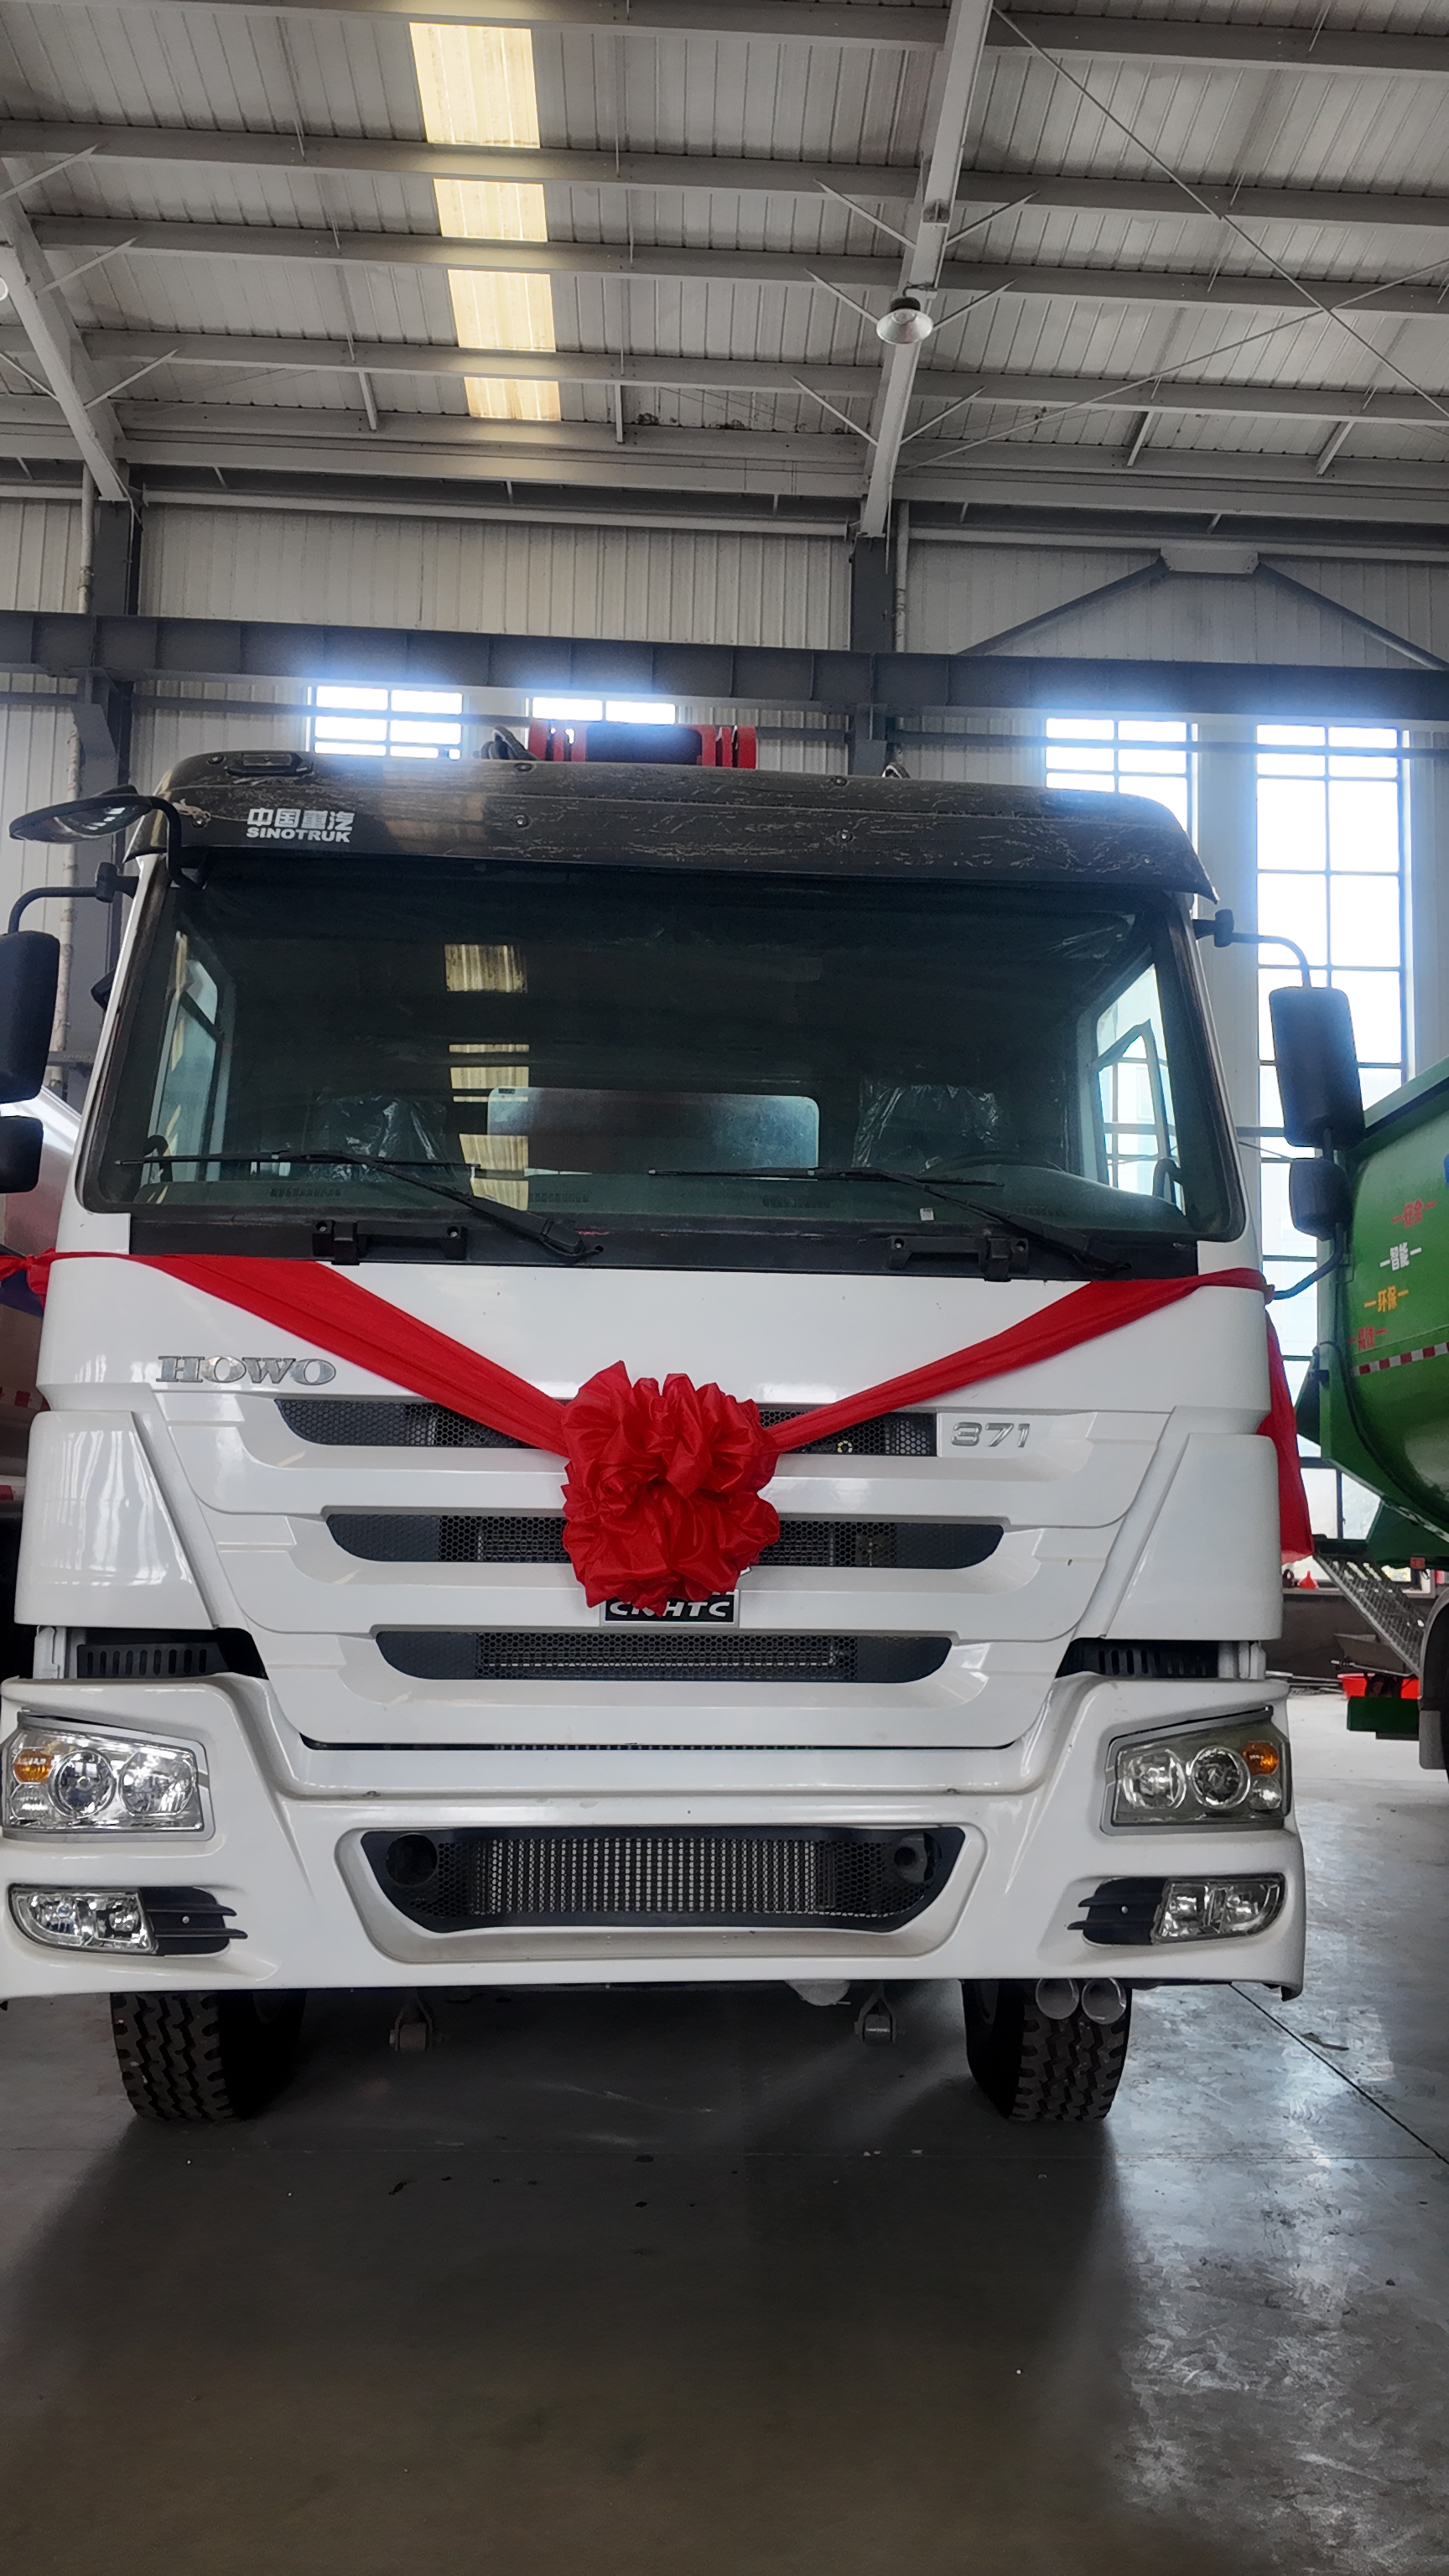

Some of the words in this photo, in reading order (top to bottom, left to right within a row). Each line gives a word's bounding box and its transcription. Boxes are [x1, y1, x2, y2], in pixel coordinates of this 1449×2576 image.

[247, 808, 355, 831] 中国重汽
[247, 827, 351, 843] SINOTRUK
[156, 1355, 336, 1385] HOWO
[951, 1421, 1030, 1447] 371
